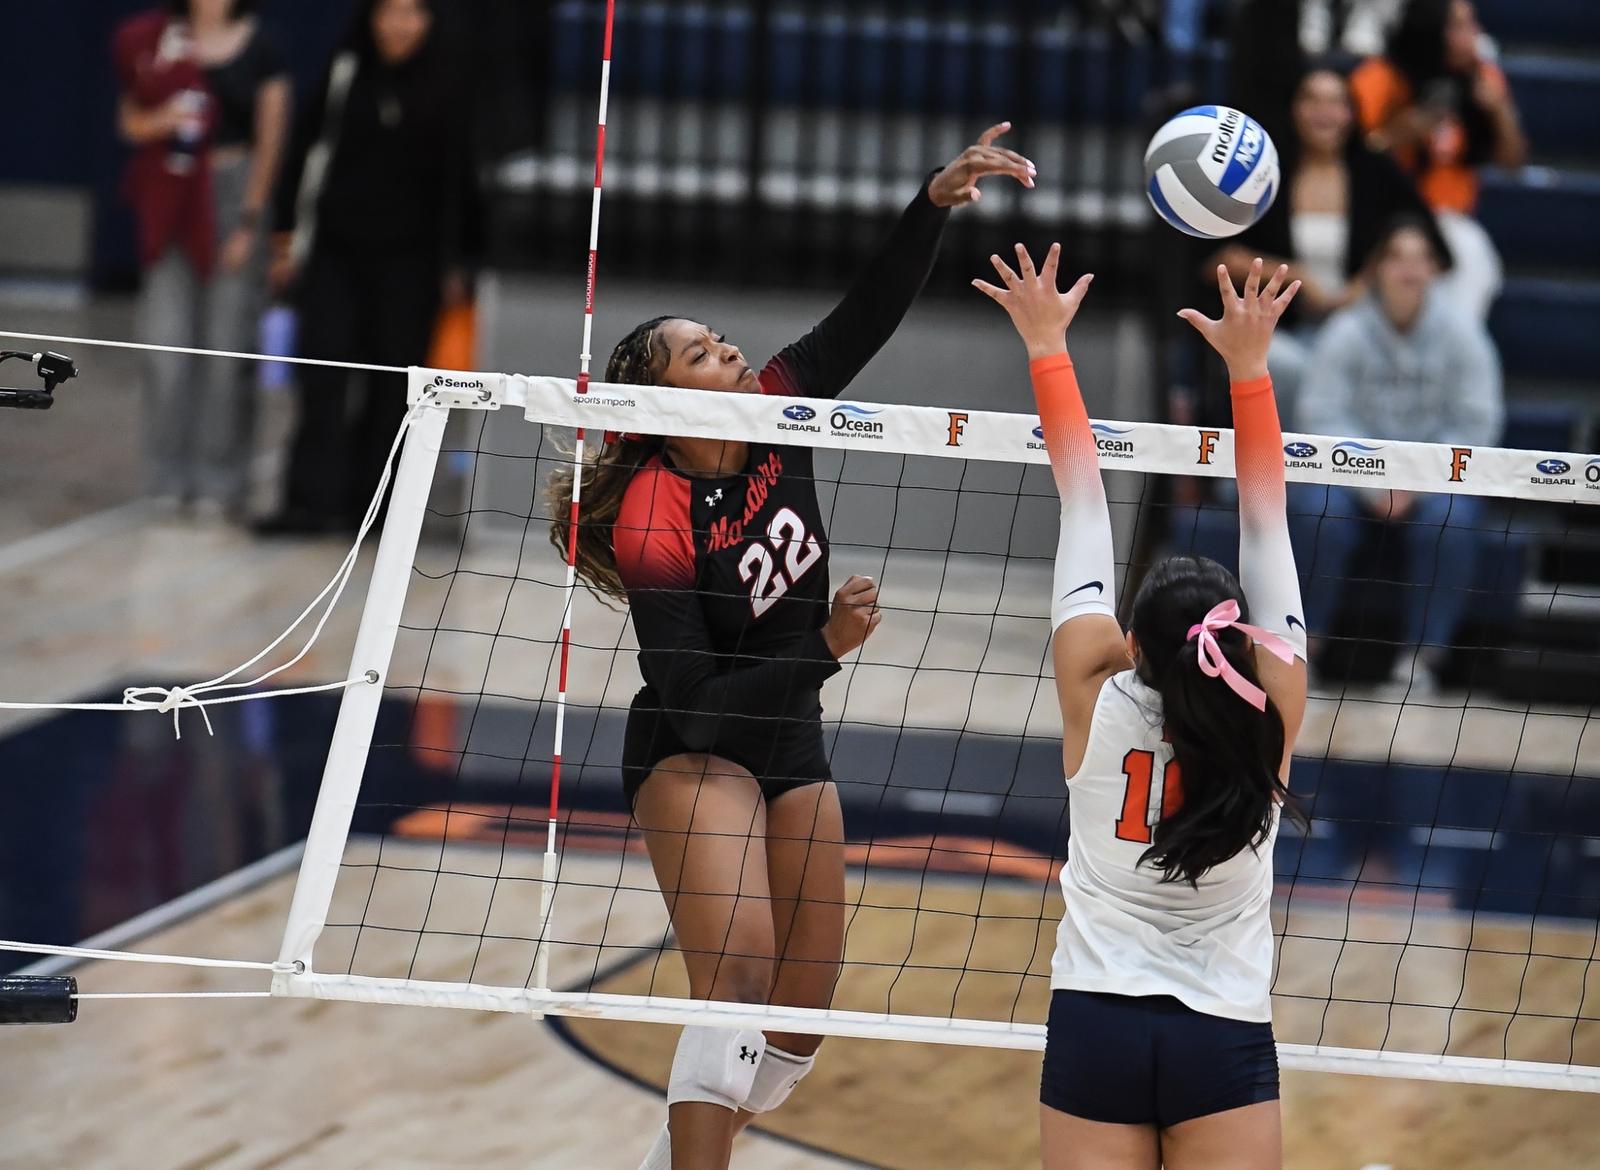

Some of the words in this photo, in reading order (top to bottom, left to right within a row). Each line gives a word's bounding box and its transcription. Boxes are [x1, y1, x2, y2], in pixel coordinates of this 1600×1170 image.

[1211, 110, 1240, 164] molten
[445, 378, 483, 388] Senoh
[573, 396, 600, 405] sports
[601, 398, 636, 407] imports
[777, 423, 820, 432] SUBARU
[830, 412, 883, 433] Ocean
[946, 412, 969, 446] F
[830, 430, 850, 438] Subaru
[858, 432, 883, 440] Fullerton
[1093, 434, 1134, 452] cean
[1197, 430, 1220, 464] F
[1284, 460, 1322, 469] UBARU
[1331, 449, 1385, 469] Ocean
[1448, 448, 1472, 482] F
[1530, 476, 1576, 486] SUBARU
[737, 507, 823, 619] 22
